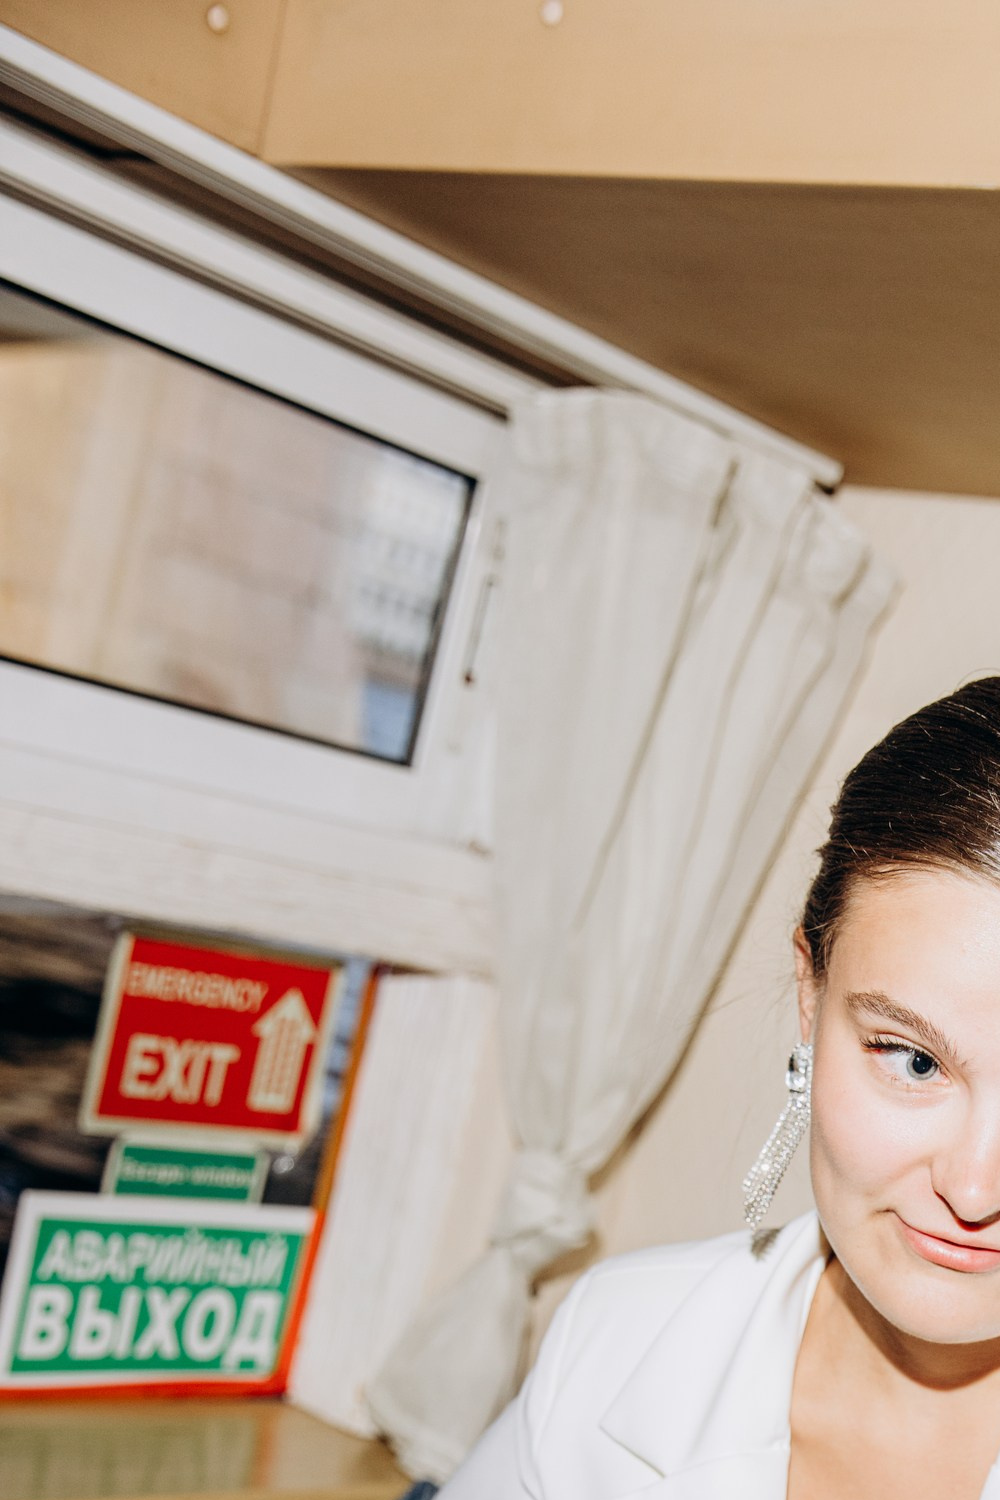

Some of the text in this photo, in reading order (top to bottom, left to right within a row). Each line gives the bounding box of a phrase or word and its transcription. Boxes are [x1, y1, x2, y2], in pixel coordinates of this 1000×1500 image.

[125, 961, 268, 1012] EMERGENCY
[119, 1032, 241, 1107] EXIT
[37, 1227, 289, 1287] АВАРИЙНЫЙ
[16, 1283, 284, 1371] ВЫХОД
